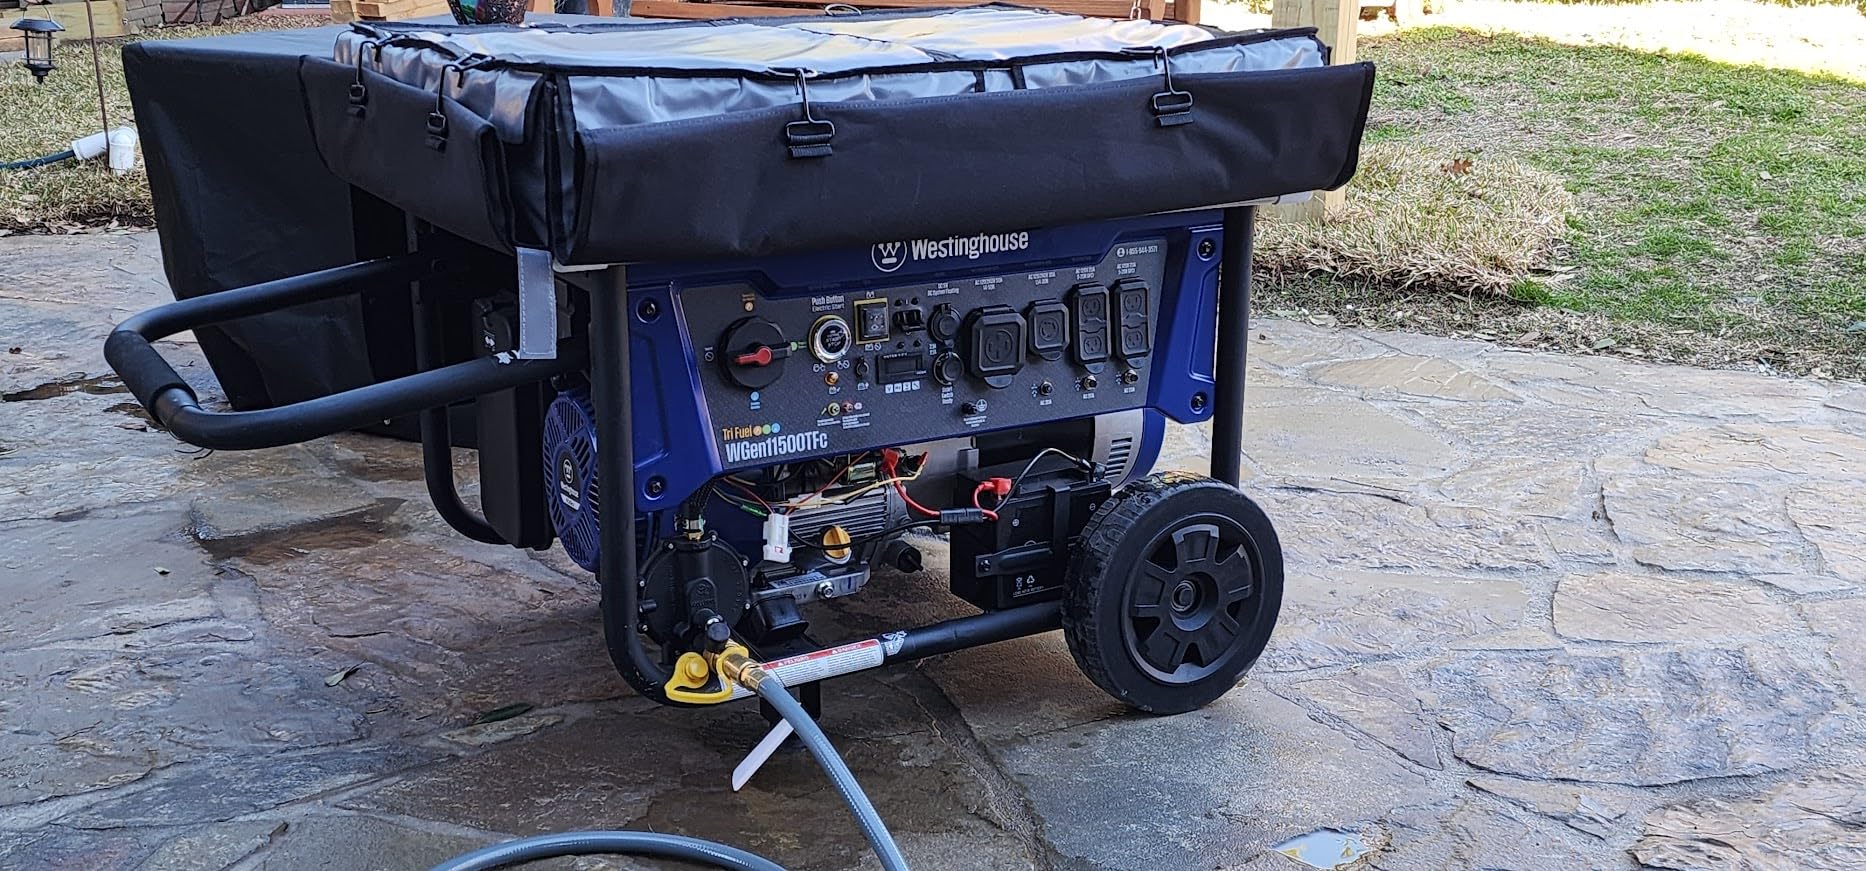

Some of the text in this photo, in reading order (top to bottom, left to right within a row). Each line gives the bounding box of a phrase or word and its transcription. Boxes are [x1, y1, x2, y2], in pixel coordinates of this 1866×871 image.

[911, 231, 1029, 260] Westinghouse
[811, 295, 845, 306] Push Button
[812, 304, 831, 312] Electric
[722, 425, 753, 441] Tri Fuel
[725, 430, 828, 463] WGen11500TFc
